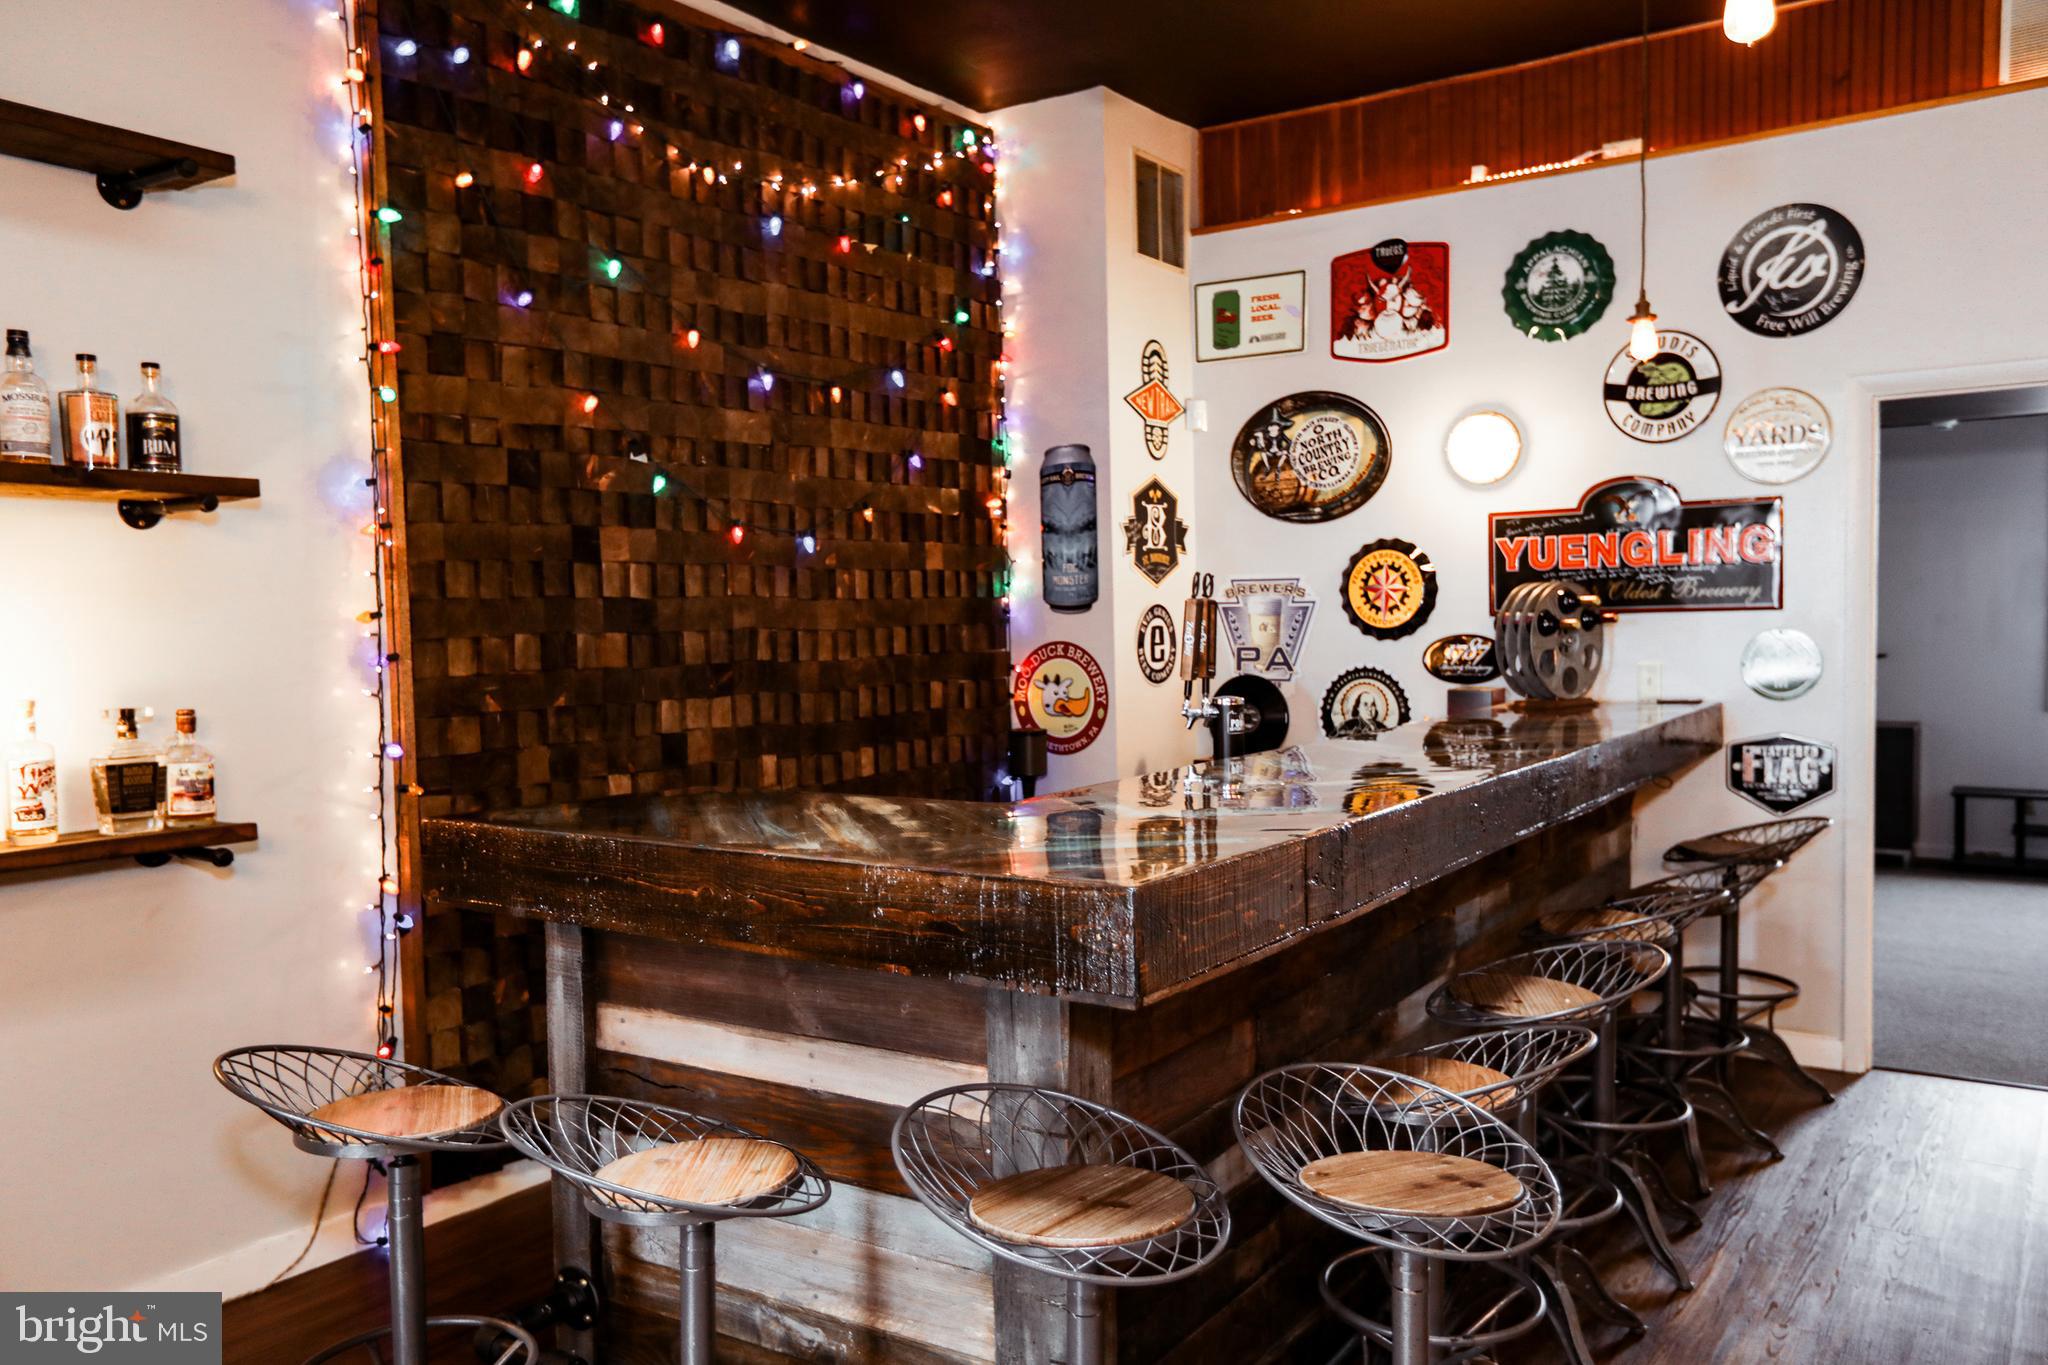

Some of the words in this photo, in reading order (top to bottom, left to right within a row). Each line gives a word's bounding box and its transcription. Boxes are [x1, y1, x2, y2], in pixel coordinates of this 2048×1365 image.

[1727, 257, 1739, 292] Liquid
[1742, 212, 1784, 242] Friends
[1787, 209, 1817, 220] First
[1756, 314, 1787, 332] Free
[1788, 310, 1821, 330] Will
[1819, 260, 1860, 316] Brewing
[1135, 388, 1155, 417] NEW
[1625, 380, 1699, 401] BREWING
[1622, 412, 1696, 437] COMPANY
[1733, 422, 1822, 447] YARDS
[143, 438, 176, 457] RUM
[1298, 437, 1350, 466] COUNTRY
[1300, 428, 1342, 451] NORTH
[1303, 452, 1351, 475] BREWING
[1495, 523, 1776, 572] YUENGLING
[1053, 575, 1089, 585] MONSTER
[1225, 583, 1306, 599] BREWERS
[1608, 581, 1662, 601] Oldest
[1671, 580, 1763, 605] Brewery
[1150, 625, 1165, 662] e
[1236, 647, 1294, 672] PA
[1017, 644, 1065, 702] MOO-DUCK
[1067, 645, 1107, 705] BREWERY
[1742, 746, 1819, 786] FLAG
